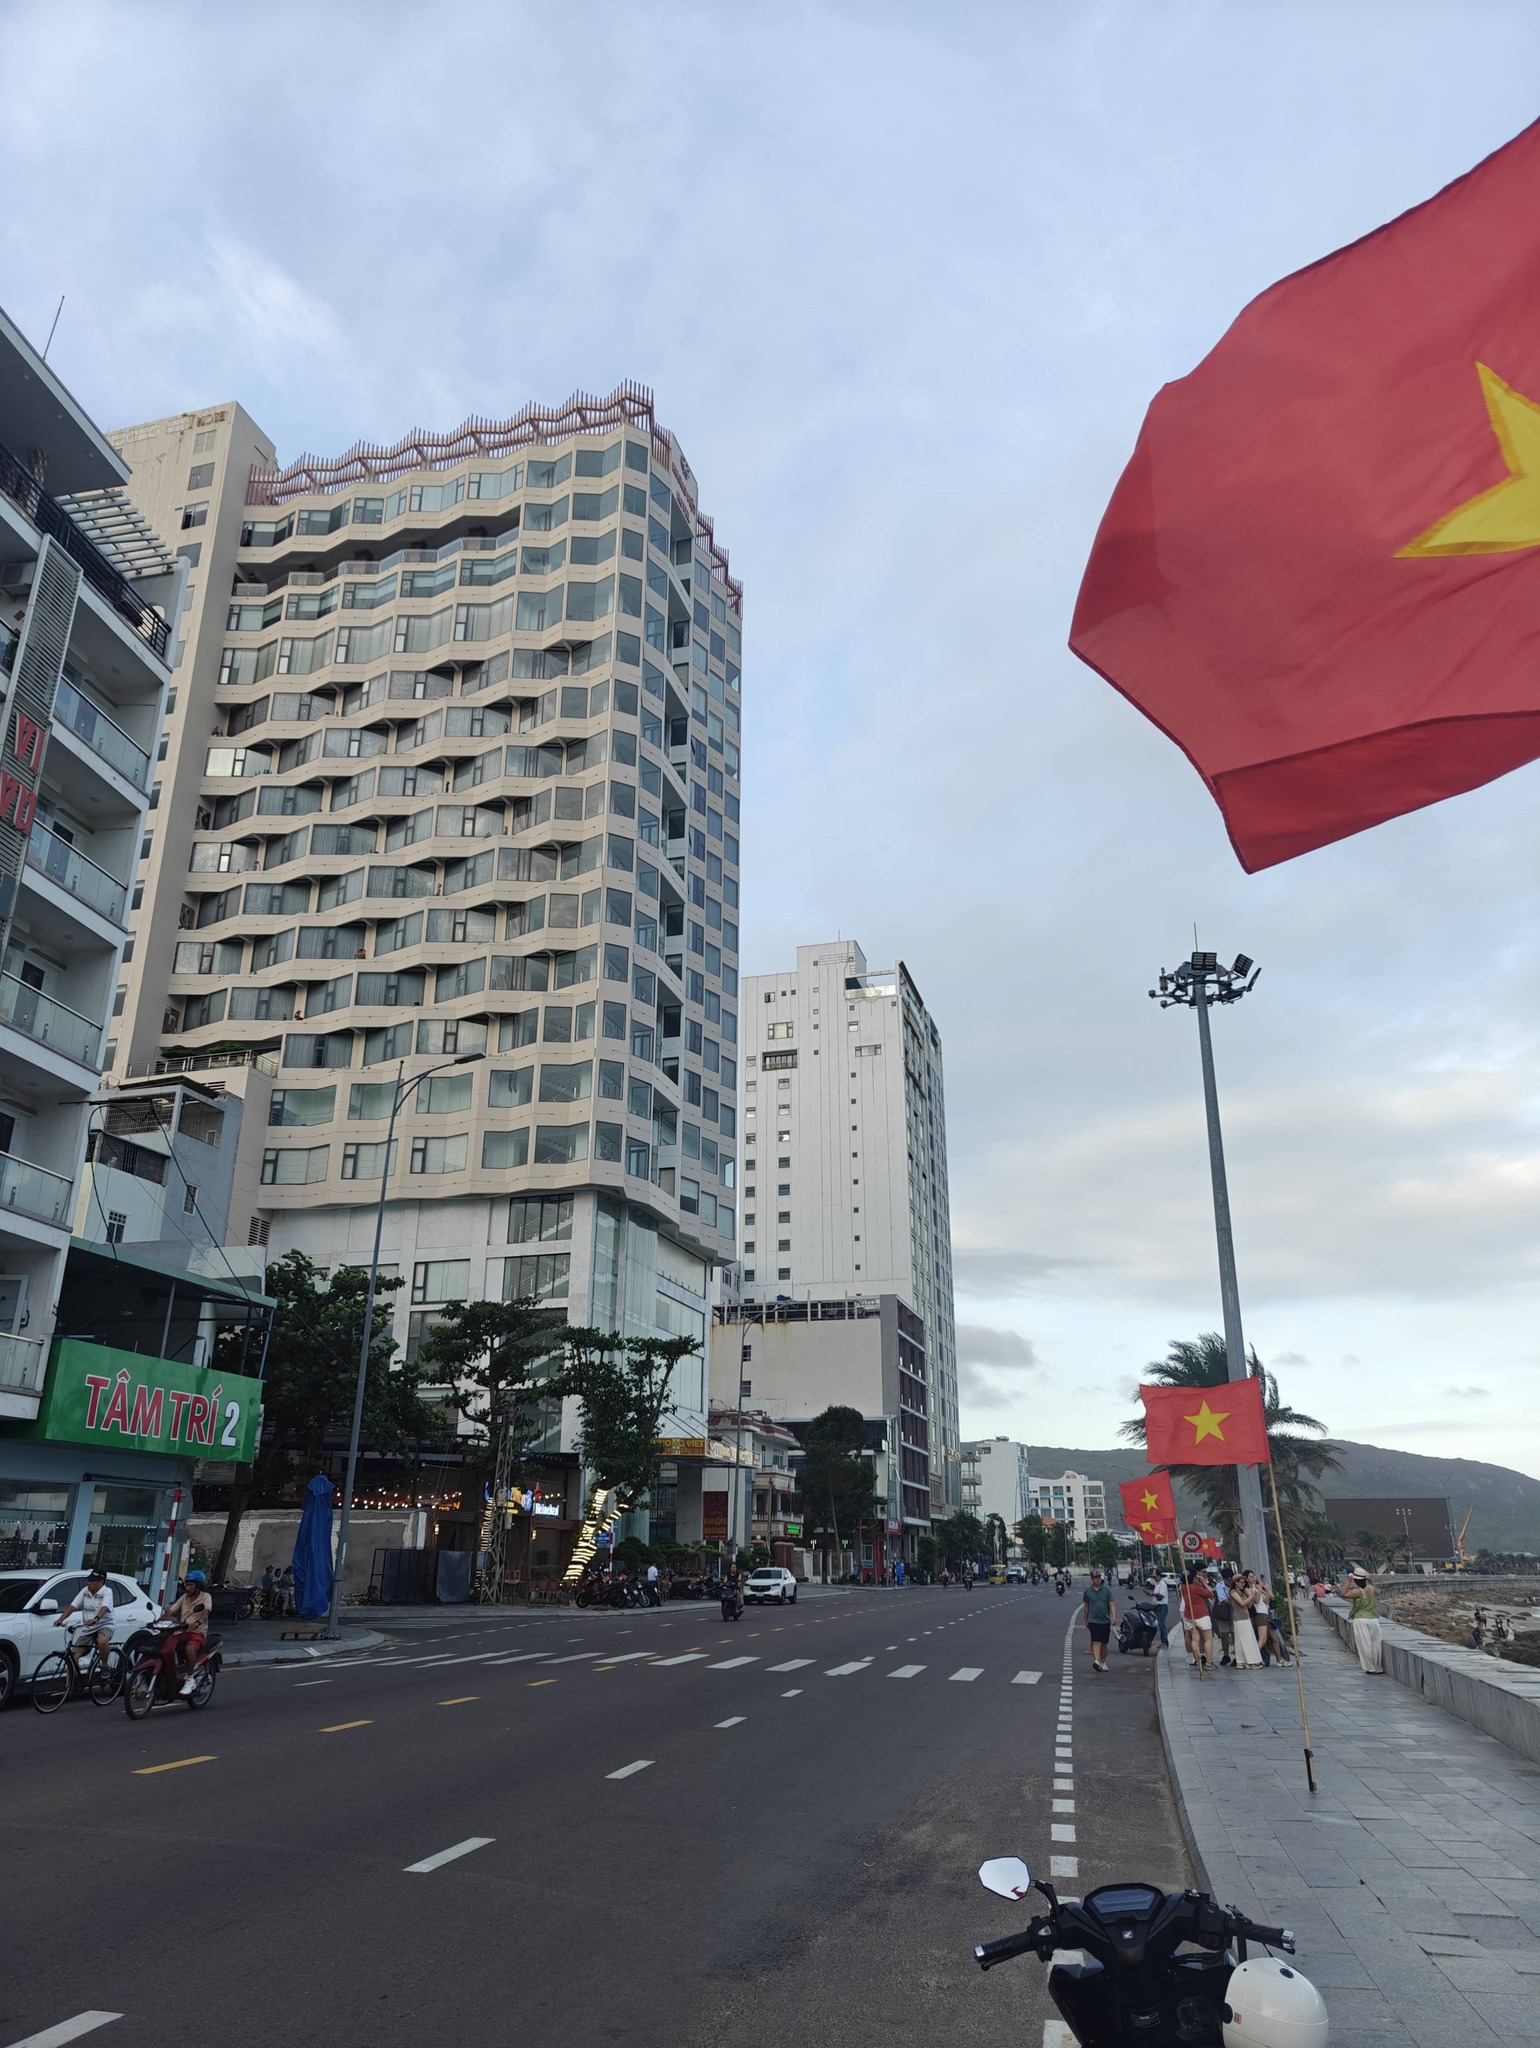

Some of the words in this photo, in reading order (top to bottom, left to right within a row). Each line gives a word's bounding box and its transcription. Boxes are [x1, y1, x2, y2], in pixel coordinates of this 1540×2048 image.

[14, 711, 46, 773] VI
[85, 1368, 165, 1438] TÂM
[169, 1384, 223, 1446] TRÍ
[221, 1400, 241, 1448] 2
[1187, 1537, 1197, 1547] 30
